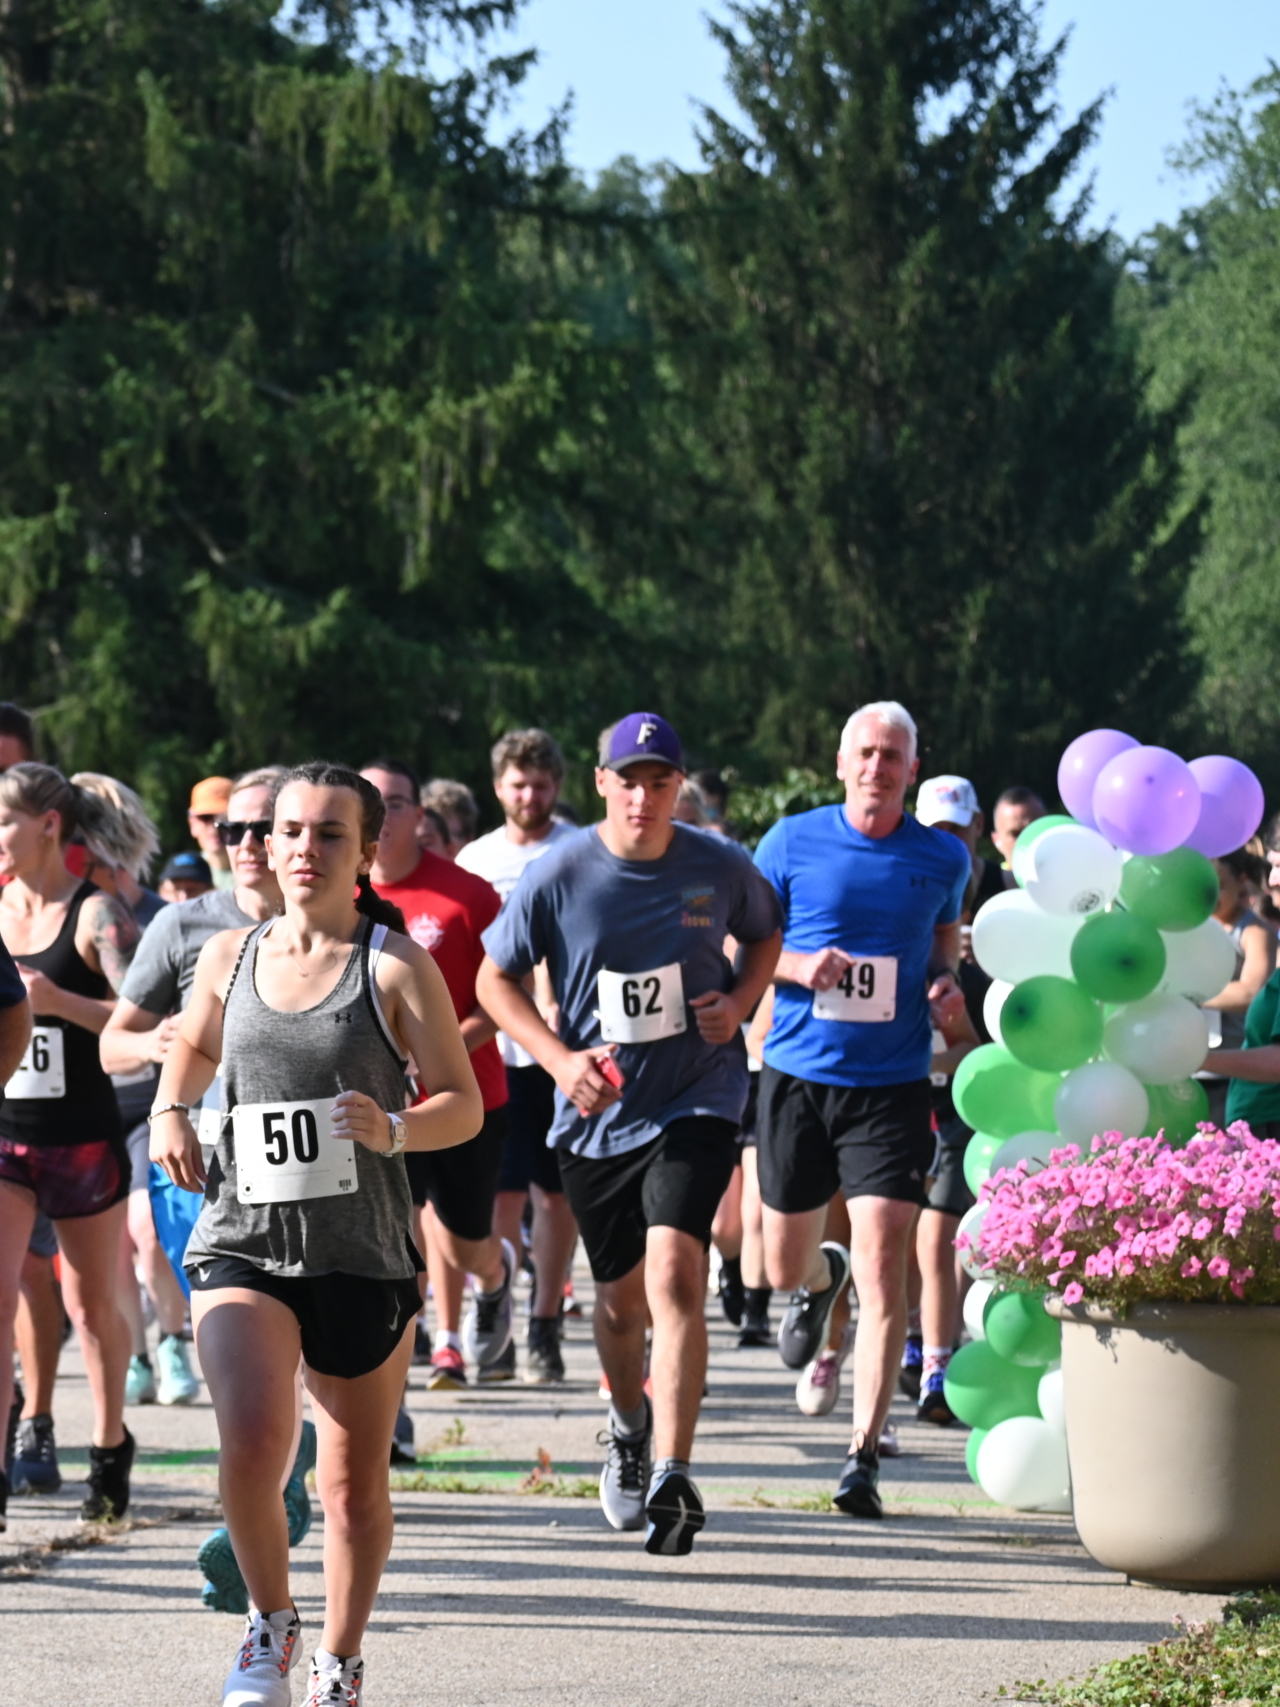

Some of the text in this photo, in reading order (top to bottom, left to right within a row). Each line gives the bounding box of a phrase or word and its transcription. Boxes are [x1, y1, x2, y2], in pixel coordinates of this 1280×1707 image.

[636, 722, 657, 745] F
[622, 977, 663, 1018] 62
[837, 962, 875, 999] 49
[20, 1034, 50, 1073] 6
[262, 1108, 319, 1166] 50
